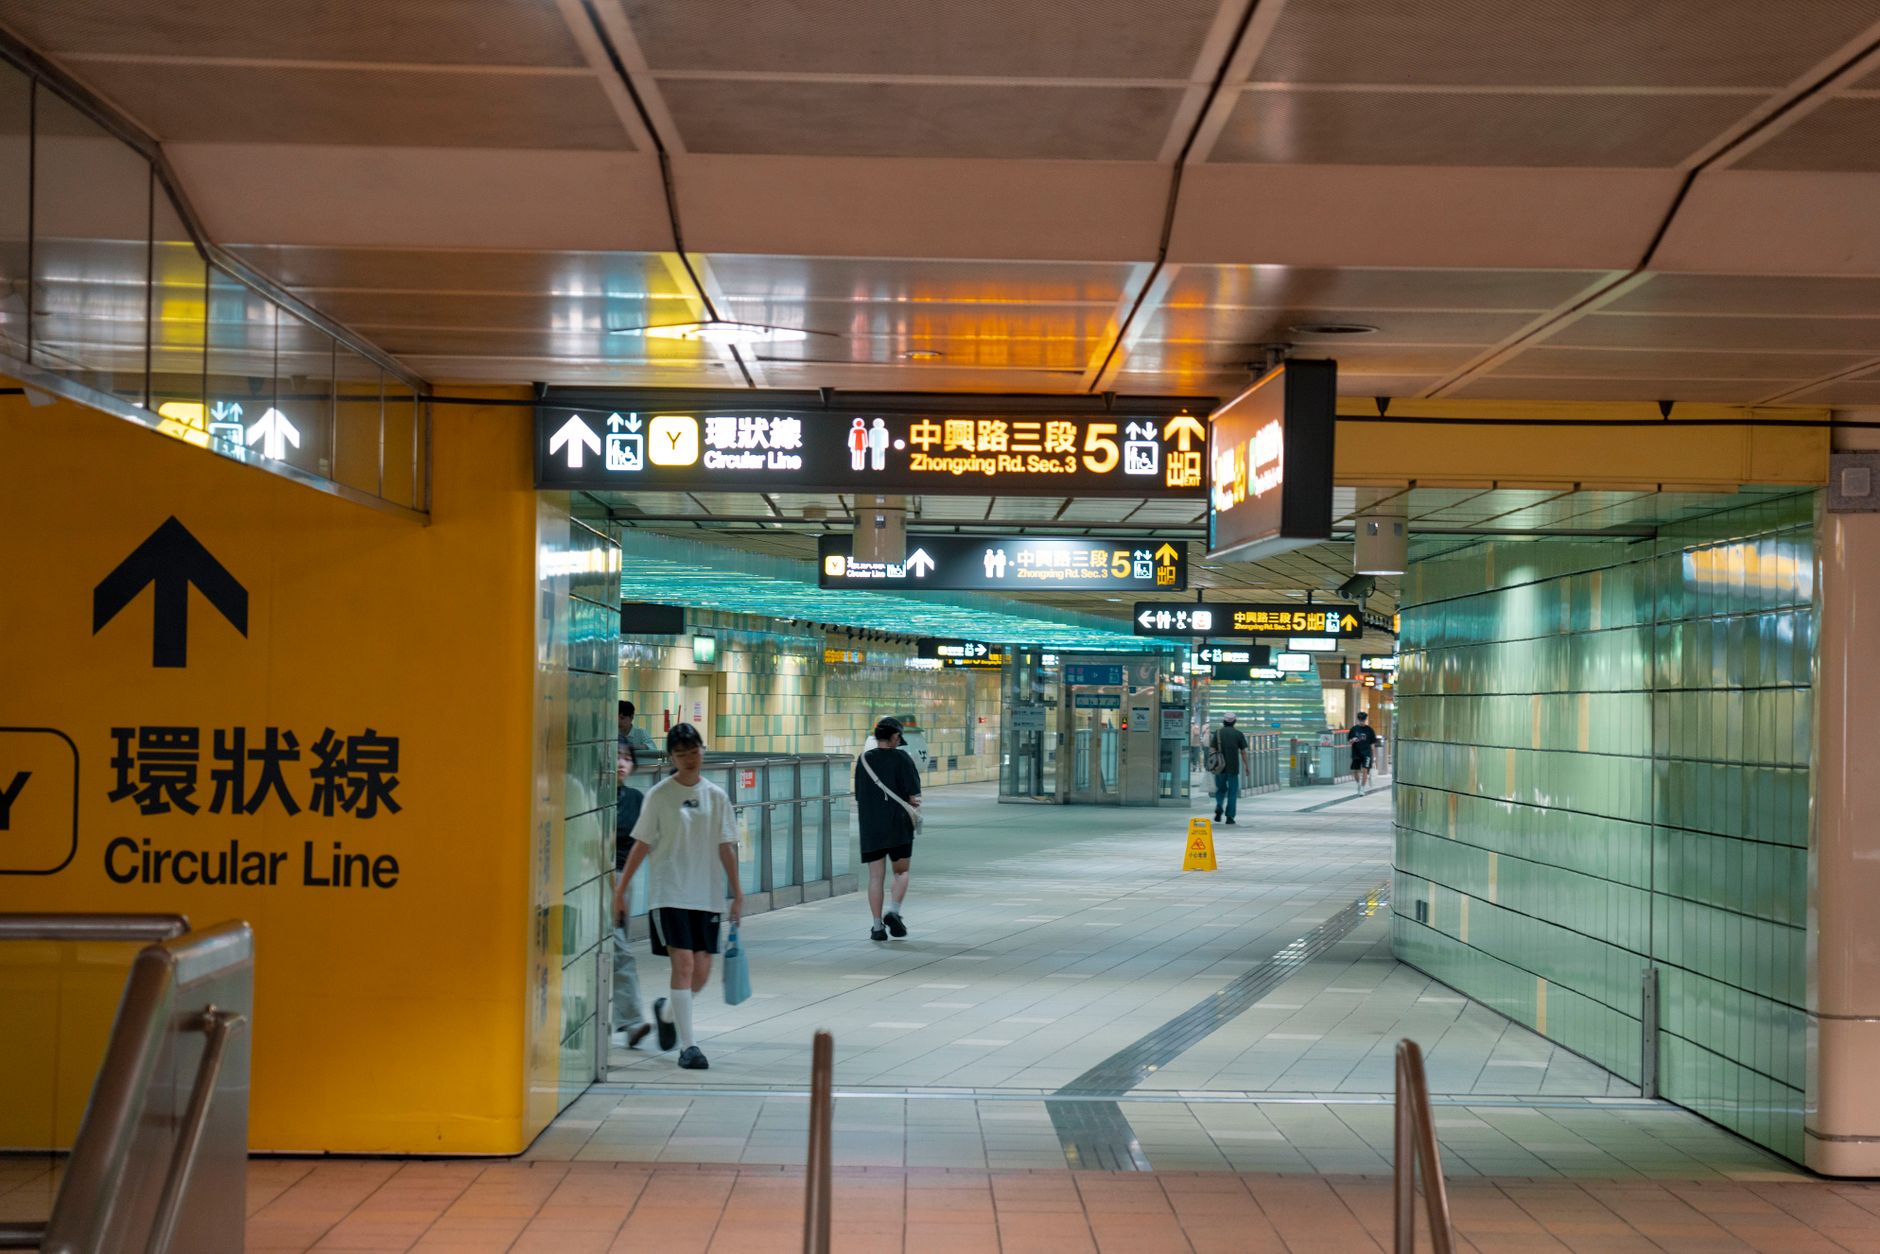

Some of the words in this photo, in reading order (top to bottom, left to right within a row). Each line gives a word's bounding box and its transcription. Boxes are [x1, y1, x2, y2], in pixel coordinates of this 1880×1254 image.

[666, 431, 682, 450] Y
[704, 417, 803, 449] 環狀線
[910, 419, 1077, 452] 中興路三段
[703, 450, 766, 469] Circular
[767, 451, 802, 470] Line
[1082, 423, 1119, 473] 5
[909, 453, 996, 475] Zhongxing
[997, 454, 1026, 473] Rd.
[1027, 455, 1064, 473] Sec.
[1065, 456, 1077, 473] 3
[1167, 451, 1201, 487] 出口
[1184, 477, 1201, 487] EXIT
[1017, 568, 1064, 580] Zhongxing
[1101, 569, 1108, 578] 3
[1111, 551, 1131, 578] 5
[1292, 612, 1307, 631] 5
[108, 727, 401, 818] 環狀線
[104, 837, 288, 886] Circular
[303, 841, 399, 888] Line
